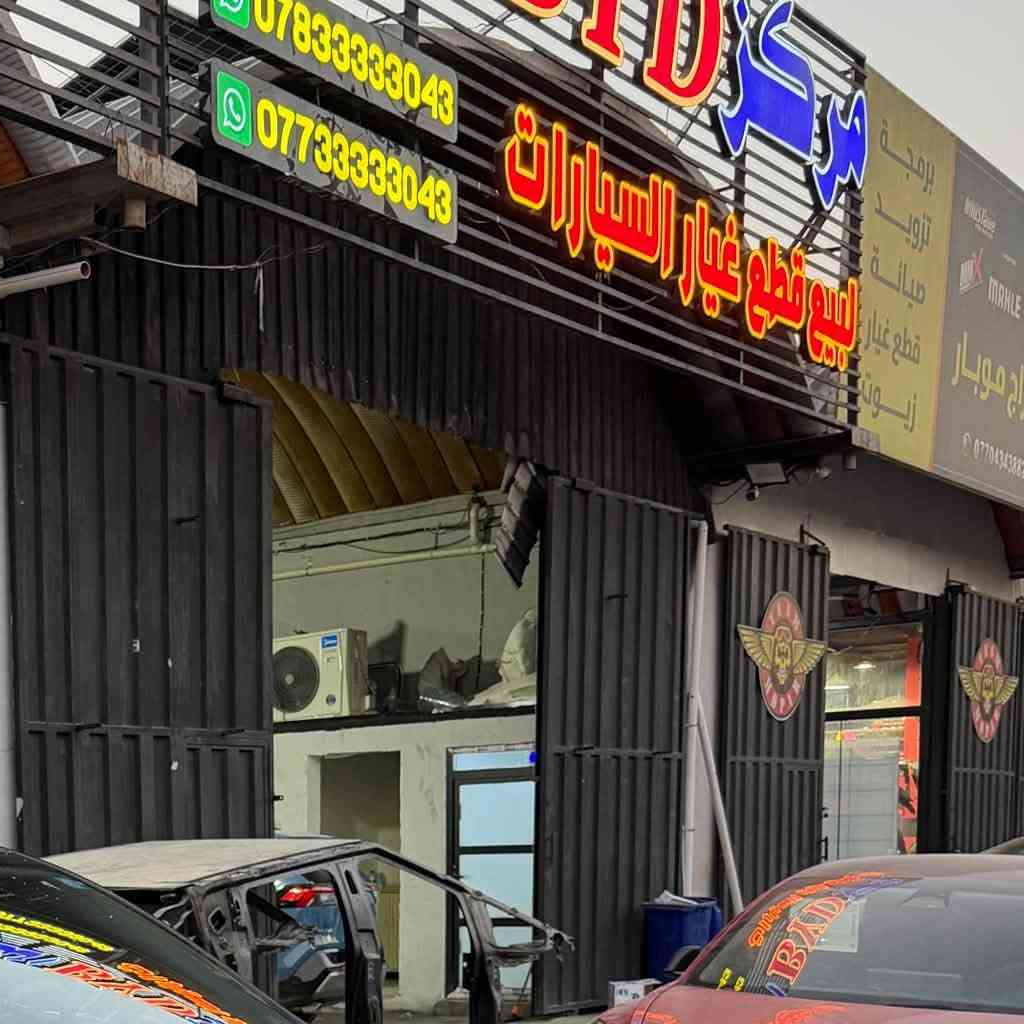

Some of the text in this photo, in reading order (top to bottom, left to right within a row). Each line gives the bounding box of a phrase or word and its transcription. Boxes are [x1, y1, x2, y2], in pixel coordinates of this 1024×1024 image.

[254, 0, 455, 126] 07833333043
[256, 98, 453, 226] 07733333043
[505, 103, 858, 372] لبيع قطع غيار السيارات
[870, 243, 927, 309] صيانة
[864, 308, 922, 366] قطع غيار
[987, 275, 1022, 320] MAHLE
